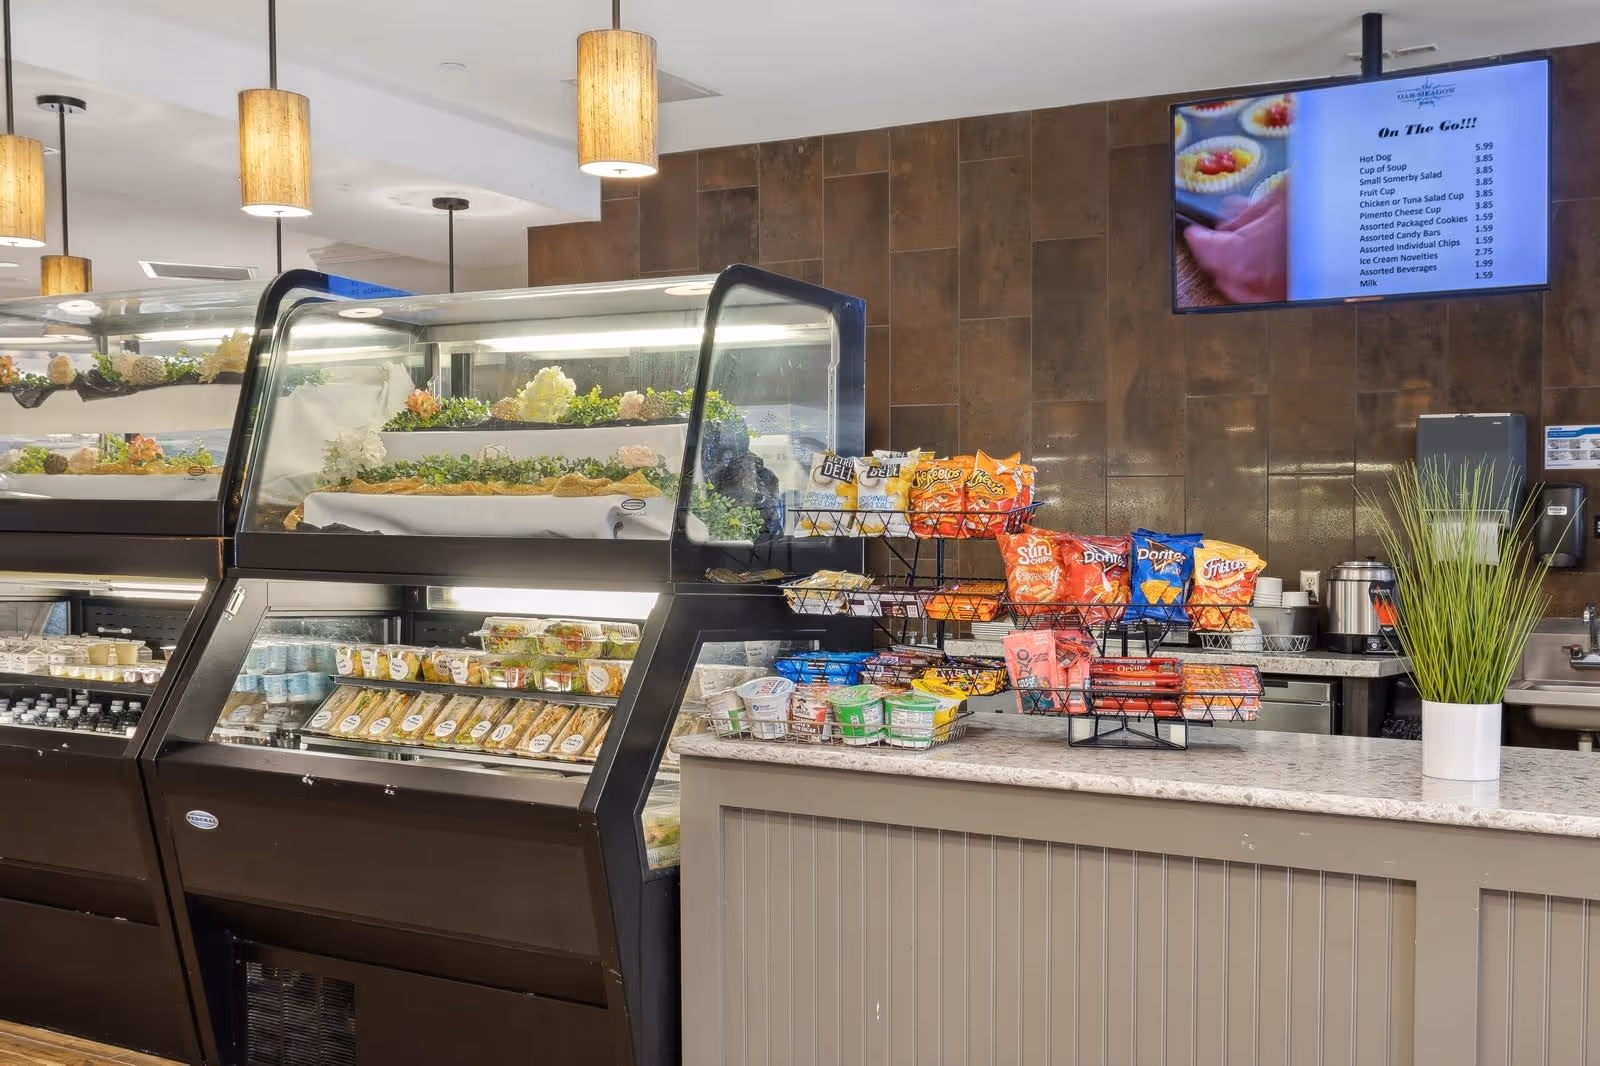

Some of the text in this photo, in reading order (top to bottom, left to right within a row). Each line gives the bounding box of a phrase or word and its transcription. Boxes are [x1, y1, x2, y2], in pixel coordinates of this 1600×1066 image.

[1378, 117, 1477, 138] On The Go!!!
[1475, 142, 1494, 151] 5.99
[1359, 153, 1392, 163] Hot Dog
[1475, 153, 1494, 163] 3.85
[1359, 163, 1408, 176] Cup of Soup
[1475, 165, 1494, 175] 3.85
[1359, 170, 1443, 186] Small Somerby Salad
[1475, 177, 1494, 186] 3.85
[1359, 187, 1396, 197] Fruit Cup
[1475, 189, 1494, 198] 3.85
[1359, 192, 1465, 208] Chicken or Tuna Salad Cup
[1475, 200, 1494, 210] 3.85
[1359, 205, 1442, 220] Pimento Cheese Cup
[1475, 212, 1494, 221] 1.59
[1359, 215, 1468, 231] Assorted Packaged Cookies
[1475, 224, 1494, 233] 1.59
[1359, 229, 1441, 242] Assorted Candy Bars
[1475, 236, 1494, 245] 1.59
[1359, 239, 1461, 254] Assorted Individual Chips
[1475, 247, 1494, 256] 2.75
[1359, 252, 1439, 265] Ice Cream Novelties
[1475, 259, 1494, 268] 1.99
[1359, 263, 1438, 276] Assorted Beverages
[1475, 271, 1494, 279] 1.59
[1359, 279, 1378, 287] Milk
[827, 455, 854, 468] METRO
[823, 461, 853, 482] DELI
[1017, 542, 1052, 565] Sun
[1202, 557, 1248, 579] Fritos
[1117, 663, 1147, 673] Orville
[187, 815, 216, 824] FEDERAL
